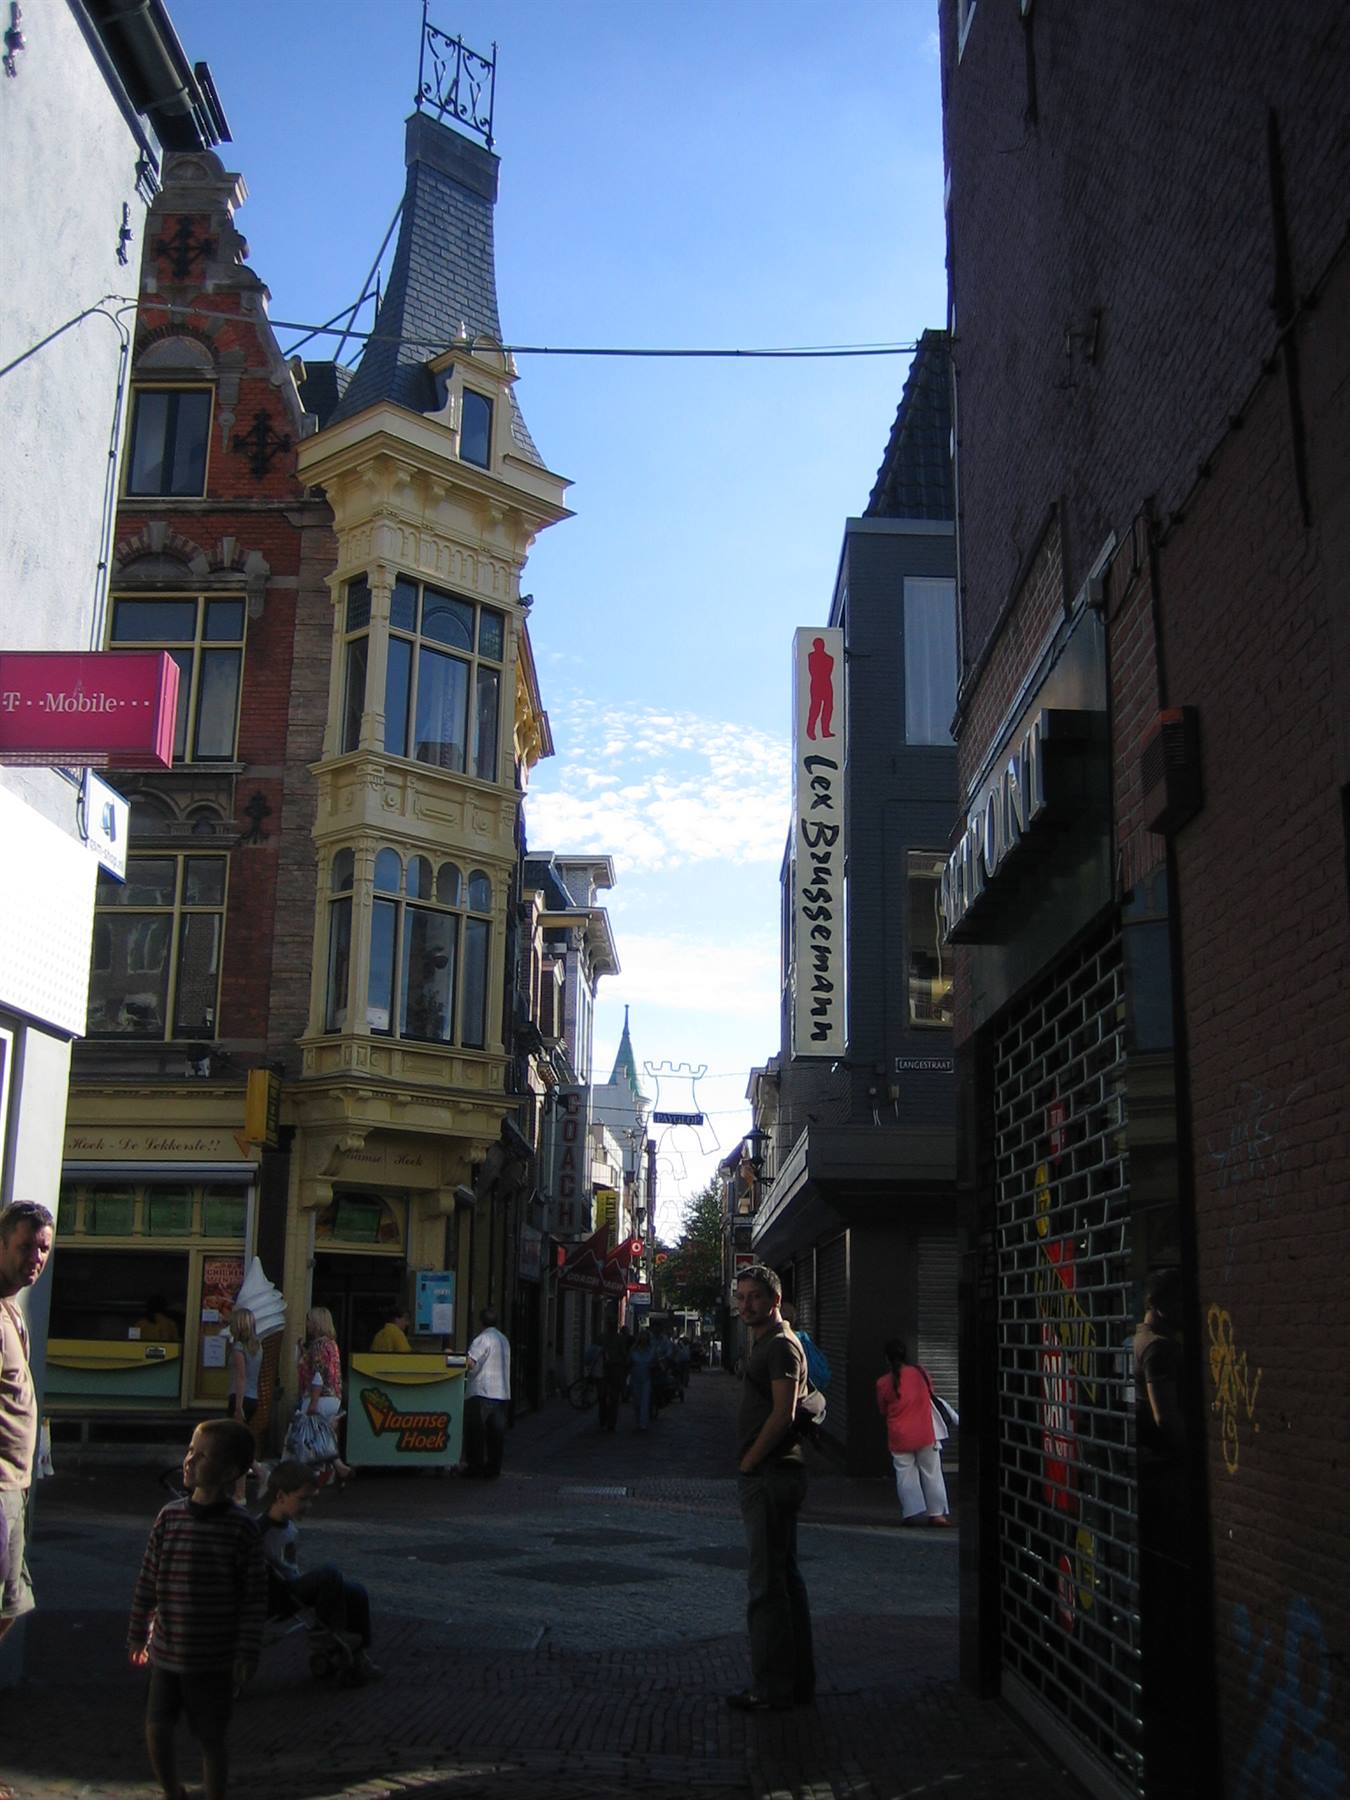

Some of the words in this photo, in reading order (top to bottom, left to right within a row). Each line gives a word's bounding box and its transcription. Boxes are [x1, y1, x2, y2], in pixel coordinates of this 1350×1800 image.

[803, 754, 839, 811] Lex
[899, 1060, 951, 1070] LANGESTRAAT
[560, 1093, 580, 1226] COACH
[1043, 1354, 1074, 1433] SALE
[400, 1431, 446, 1449] Hoek
